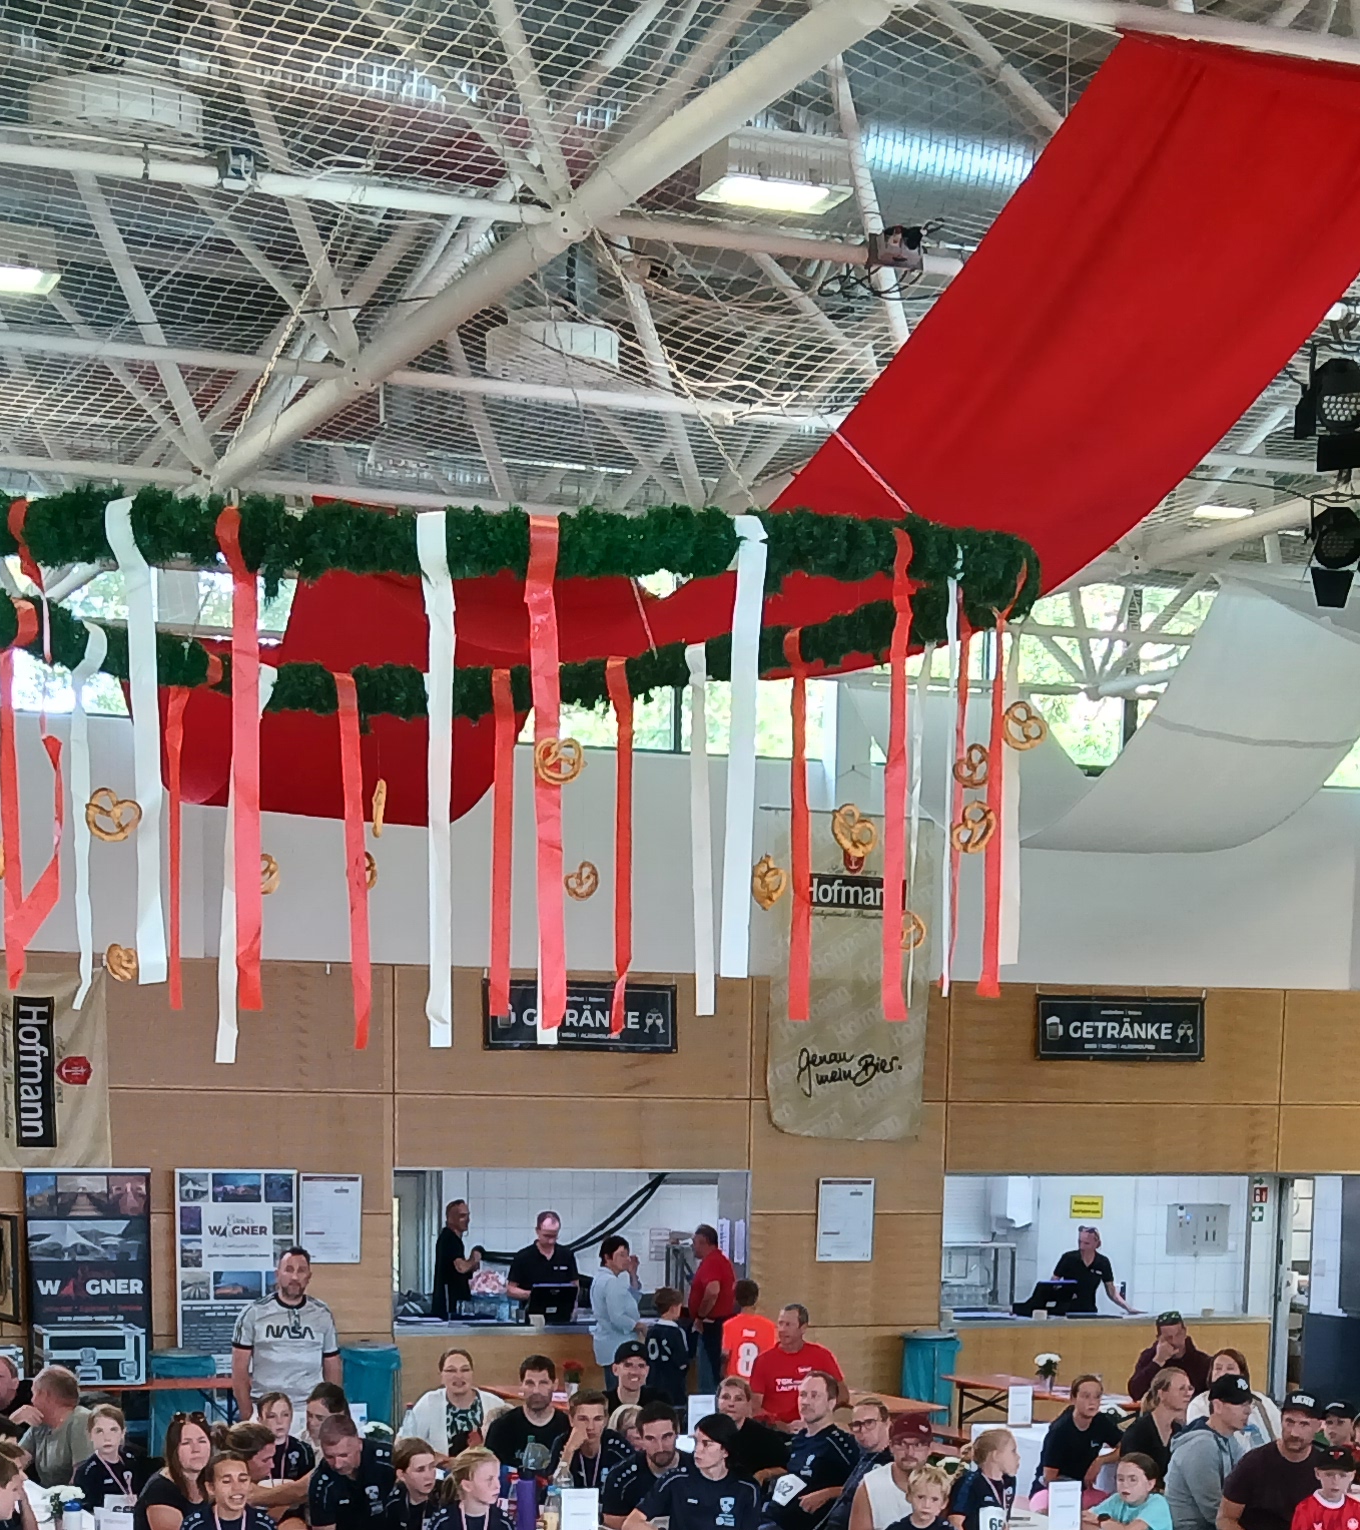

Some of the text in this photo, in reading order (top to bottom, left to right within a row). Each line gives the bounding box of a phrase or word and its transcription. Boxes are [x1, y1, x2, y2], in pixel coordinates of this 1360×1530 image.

[522, 1004, 640, 1029] GRÄNE
[1069, 1018, 1173, 1040] GETRÄNKE
[18, 1005, 50, 1138] Hofmann
[797, 1047, 856, 1098] Genau
[816, 1069, 855, 1086] mein
[265, 1325, 315, 1340] NASA
[737, 1342, 759, 1378] 8
